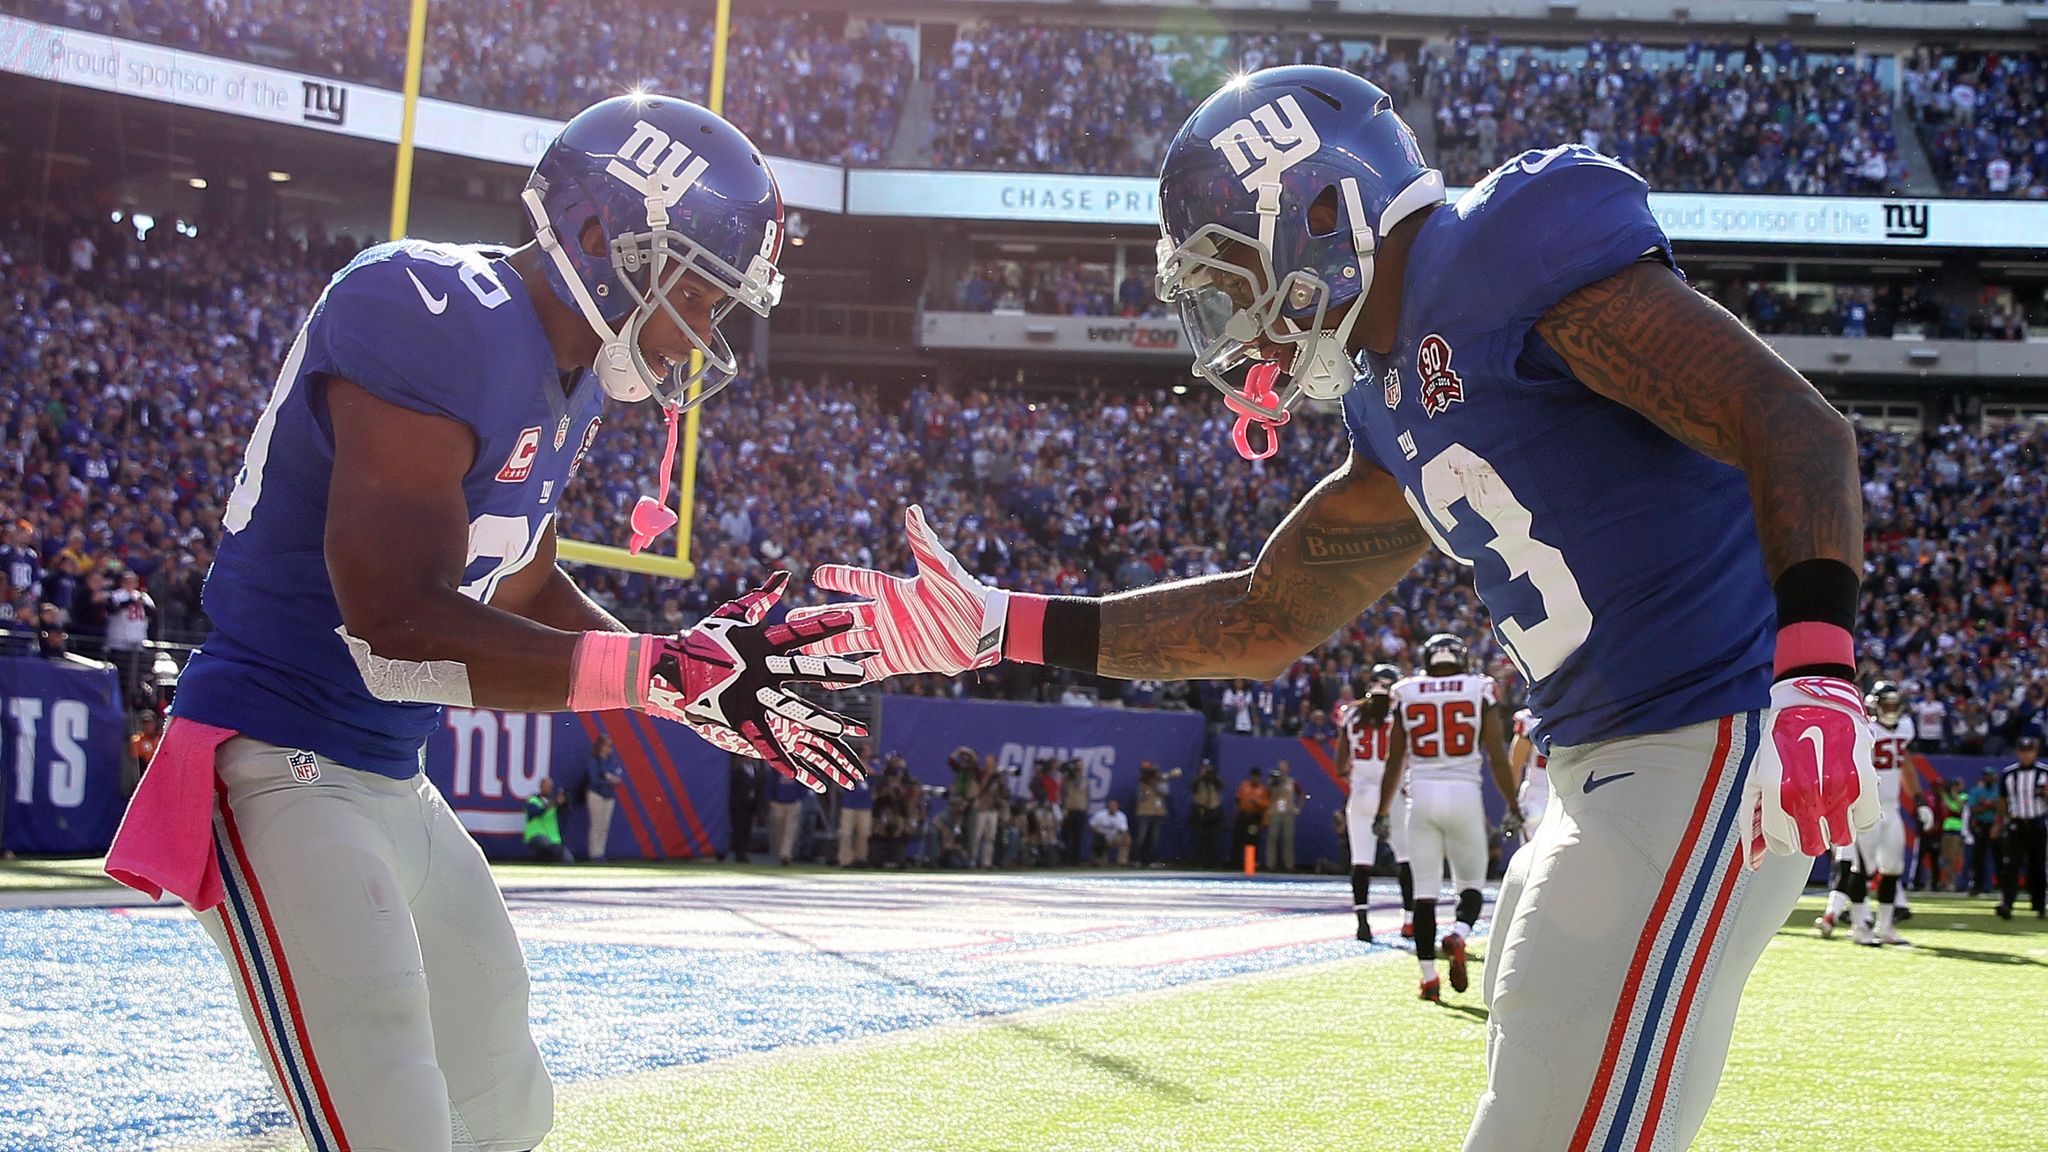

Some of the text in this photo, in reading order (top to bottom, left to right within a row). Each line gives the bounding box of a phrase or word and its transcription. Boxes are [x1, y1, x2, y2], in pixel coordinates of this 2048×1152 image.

[127, 61, 217, 95] sponsor
[226, 76, 248, 101] of
[254, 80, 289, 110] the
[1001, 186, 1093, 211] CHASE
[1711, 207, 1799, 233] sponsor
[1805, 206, 1827, 232] of
[1833, 209, 1870, 233] the
[1088, 322, 1178, 347] verizon
[1422, 342, 1441, 375] 90
[509, 431, 539, 470] C
[1306, 533, 1416, 556] Bourbon
[1404, 442, 1594, 688] 3
[1407, 701, 1475, 757] 26
[295, 763, 318, 780] NFL
